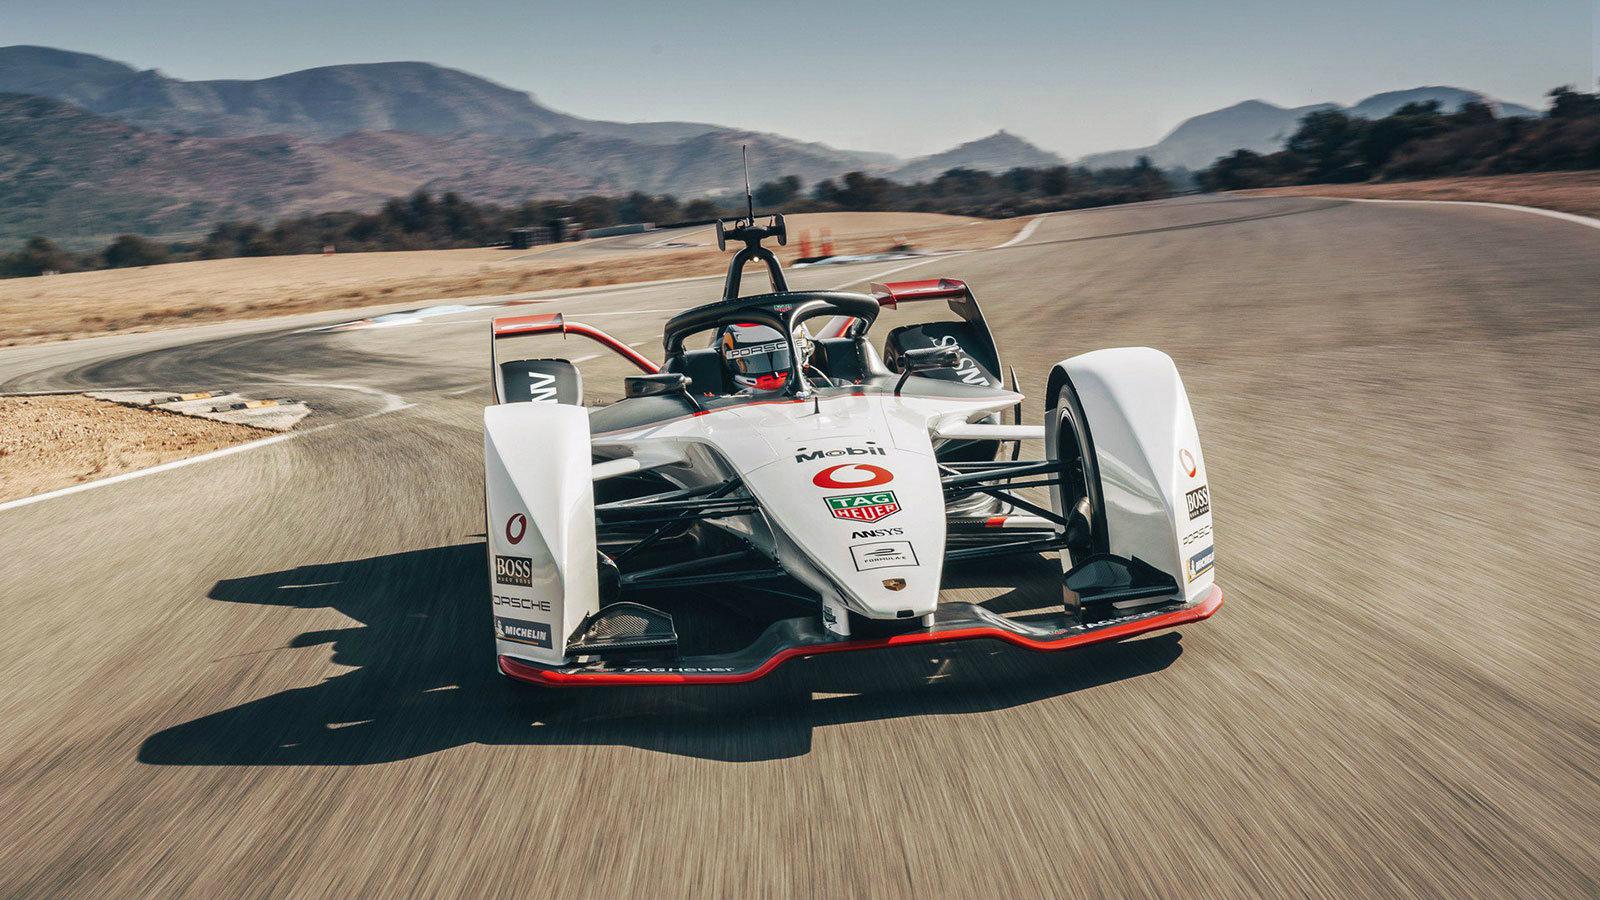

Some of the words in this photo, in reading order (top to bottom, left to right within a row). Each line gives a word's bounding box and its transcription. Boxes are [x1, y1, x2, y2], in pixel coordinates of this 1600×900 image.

[795, 442, 886, 463] Mobil
[833, 494, 890, 507] TAG
[1187, 488, 1208, 511] BOSS
[836, 504, 895, 520] HEUER
[852, 528, 904, 539] ANSYS
[496, 557, 531, 578] BOSS
[505, 625, 547, 641] MICHELIN
